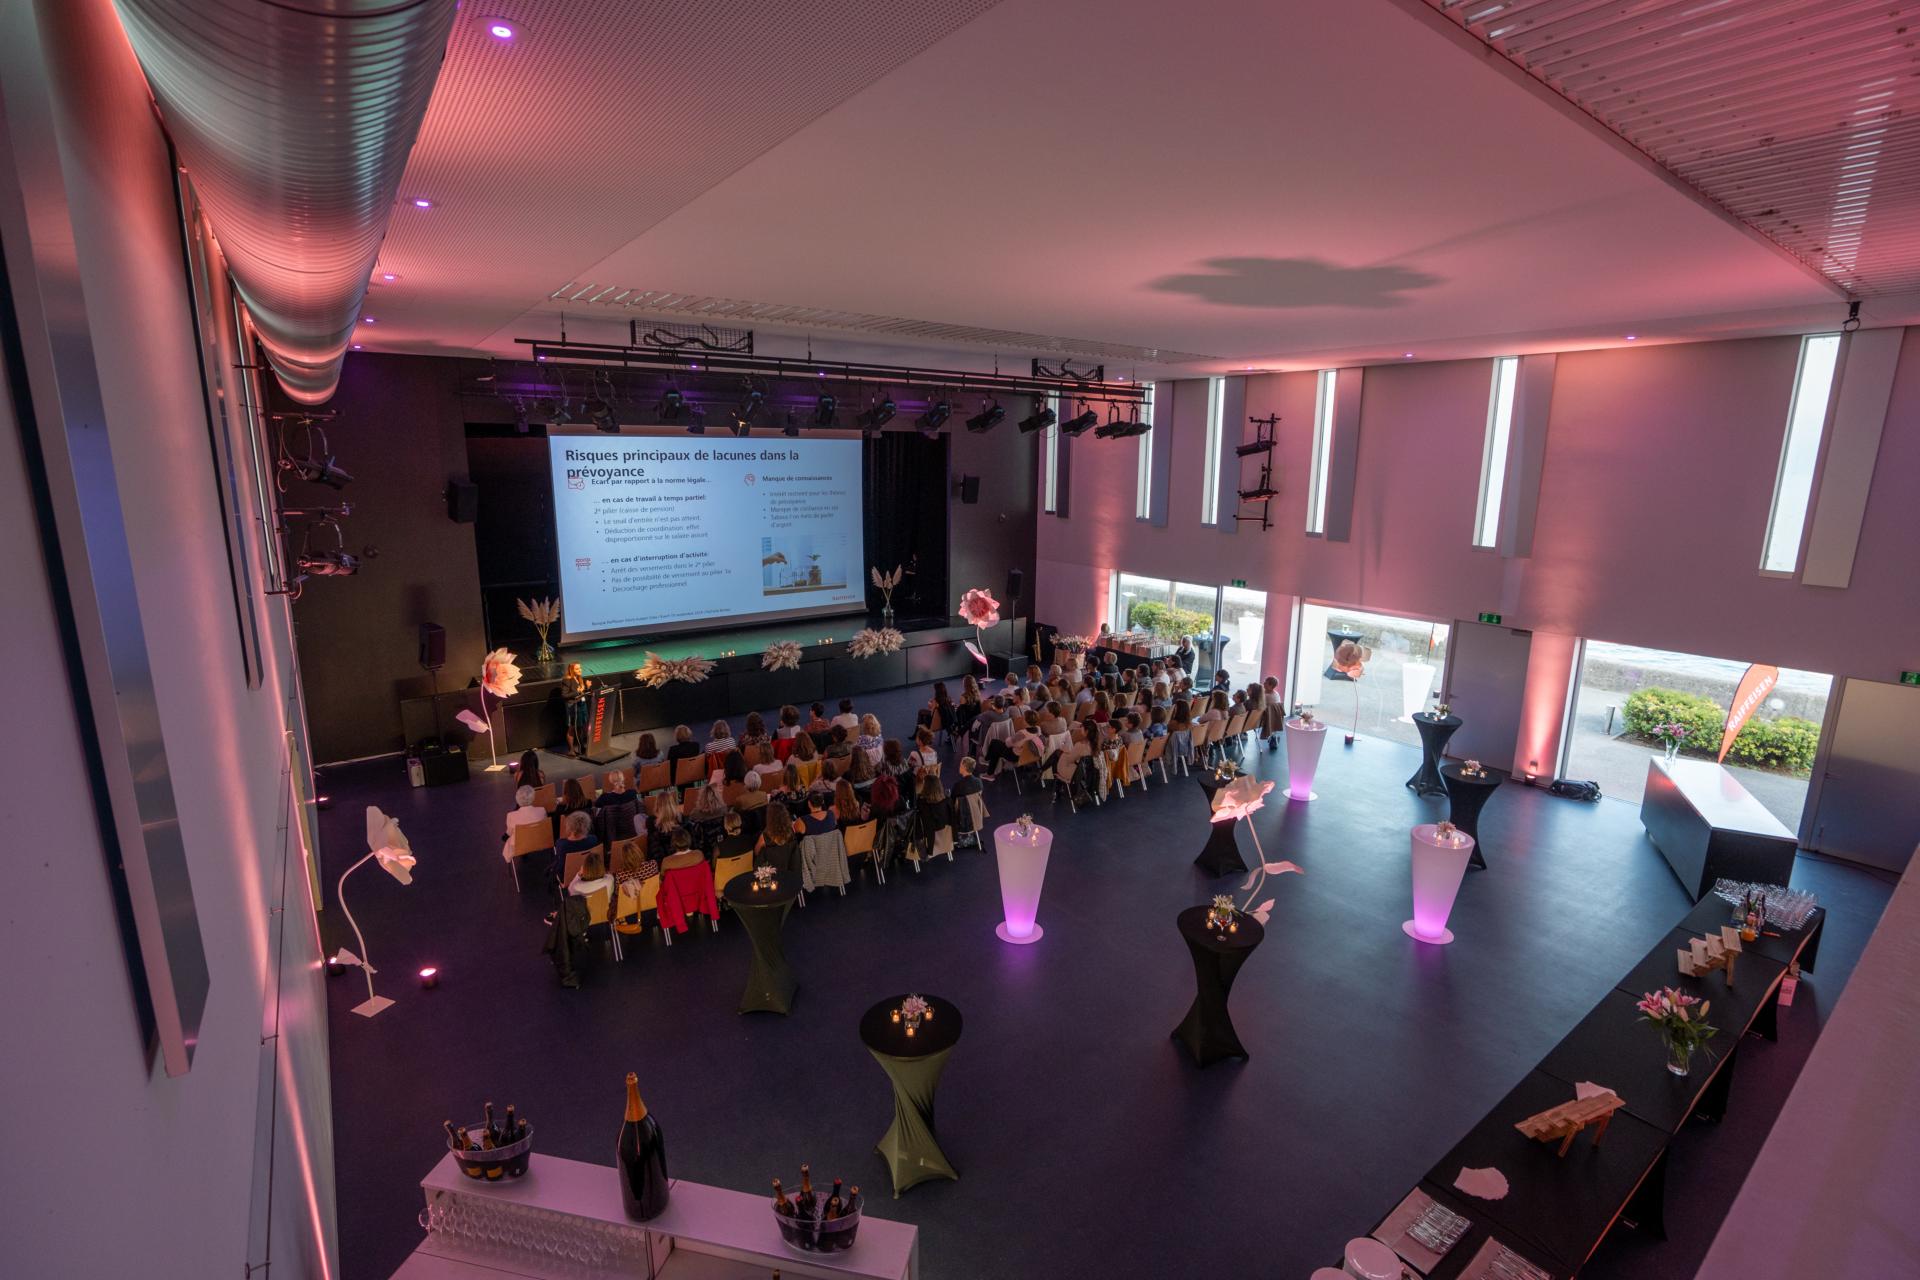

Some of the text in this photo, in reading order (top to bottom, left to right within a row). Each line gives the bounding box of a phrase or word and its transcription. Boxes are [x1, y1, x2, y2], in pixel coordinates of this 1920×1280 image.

[565, 449, 799, 463] Risques principaux de lacunes dans la
[566, 465, 645, 480] prévoyance
[611, 478, 623, 486] par
[624, 477, 650, 485] rapport
[762, 475, 785, 483] Manque
[604, 526, 636, 535] Déduction
[633, 553, 678, 562] d'interruption
[673, 562, 688, 570] dans
[662, 572, 670, 580] de
[1728, 675, 1774, 732] RAIFFEISEN
[594, 697, 606, 743] RAIFFEISEN
